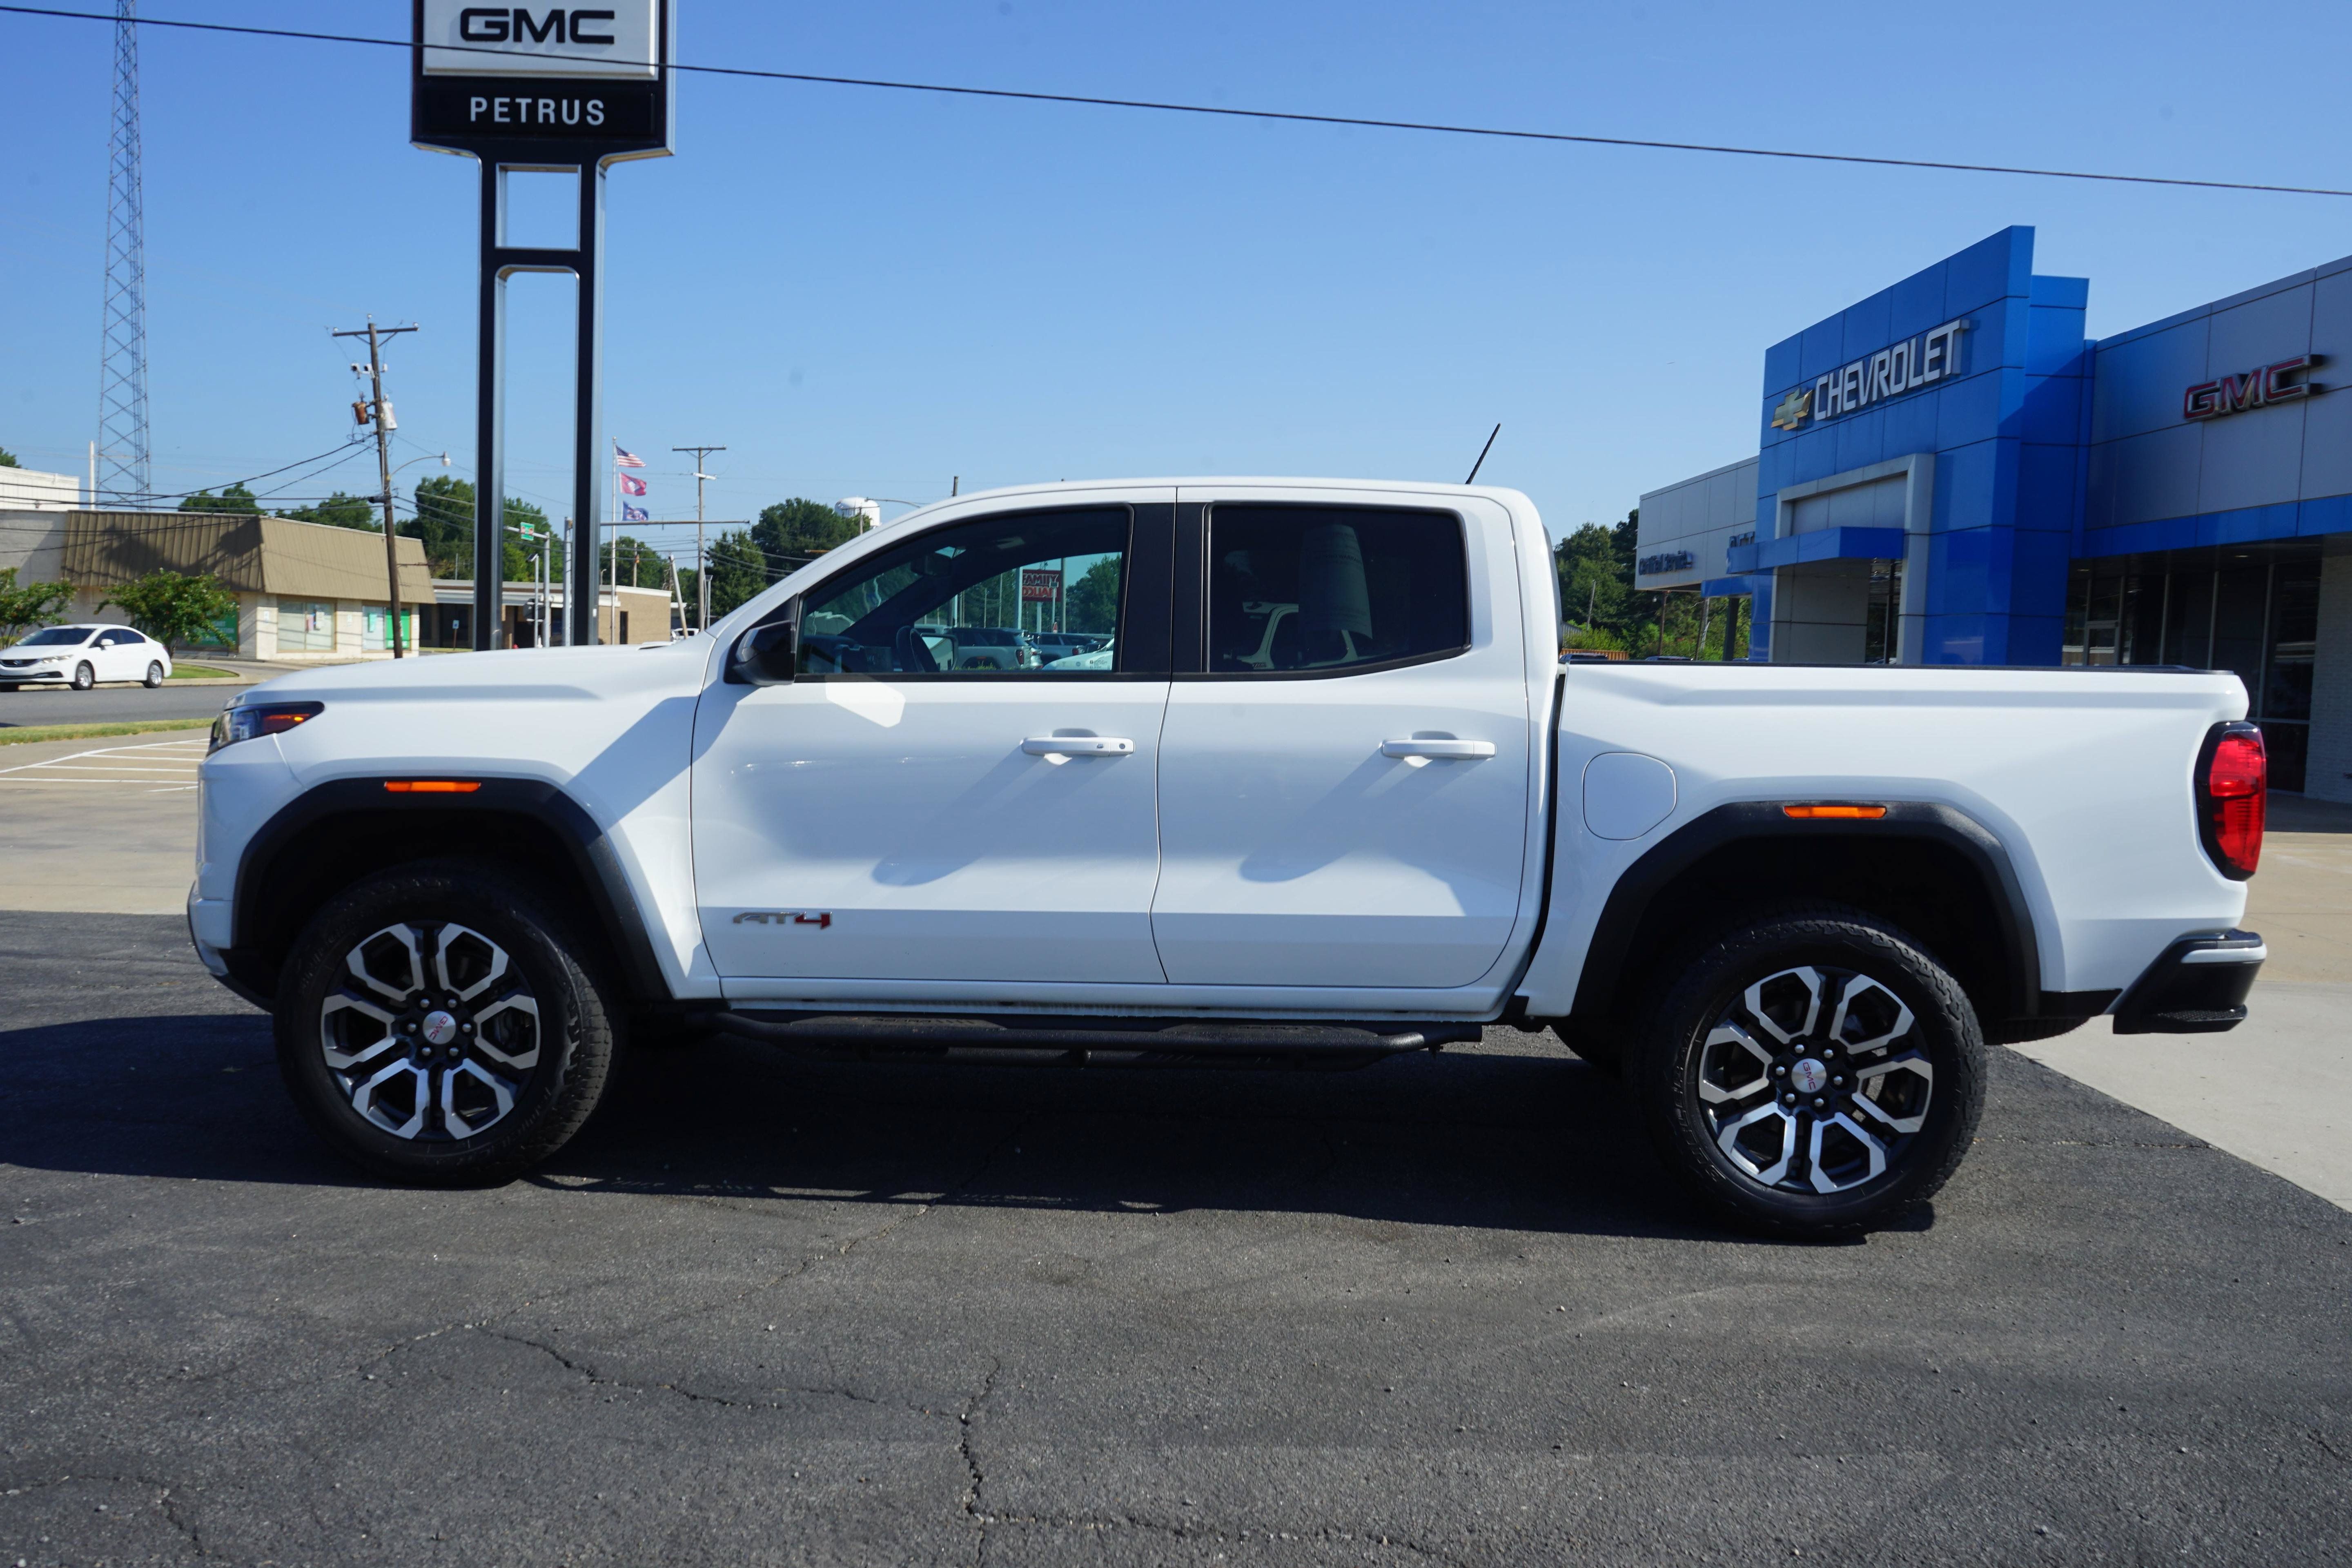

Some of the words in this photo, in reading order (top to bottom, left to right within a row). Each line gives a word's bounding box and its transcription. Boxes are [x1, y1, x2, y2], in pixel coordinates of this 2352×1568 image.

[460, 8, 615, 44] GMC
[470, 97, 605, 125] PETRUS
[1814, 319, 1969, 421] CHEVROLET
[2184, 354, 2323, 422] GMC
[733, 911, 833, 930] AT4
[429, 1016, 448, 1040] GMC
[1803, 1062, 1816, 1090] GMC
